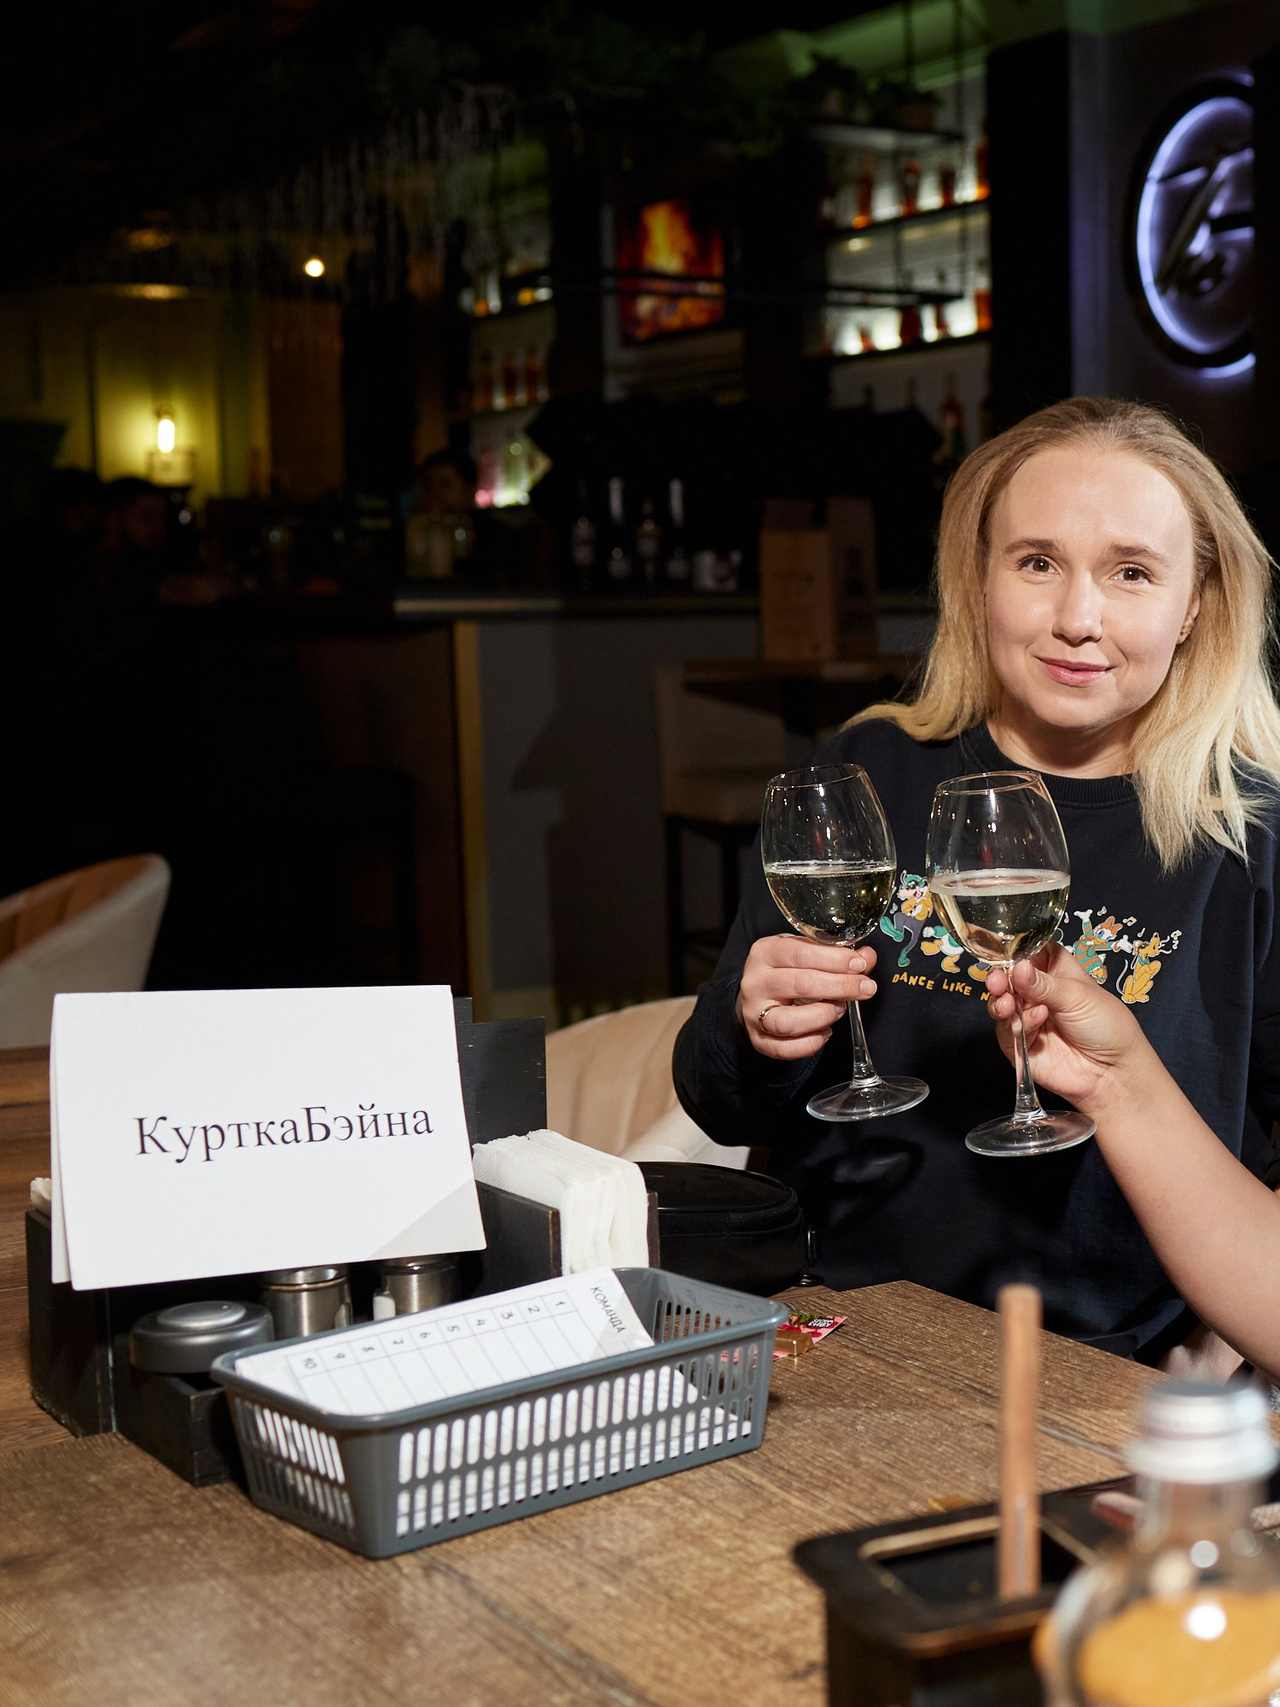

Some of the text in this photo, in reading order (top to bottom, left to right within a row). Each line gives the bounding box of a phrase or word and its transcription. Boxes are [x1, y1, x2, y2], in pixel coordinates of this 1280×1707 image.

[892, 971, 935, 990] DANCE
[942, 978, 972, 996] LIKE
[132, 1102, 435, 1163] КурткаБэйна
[501, 1311, 514, 1320] 3
[527, 1305, 541, 1314] 2
[590, 1286, 626, 1333] КОМАНДА
[446, 1324, 460, 1332] 5
